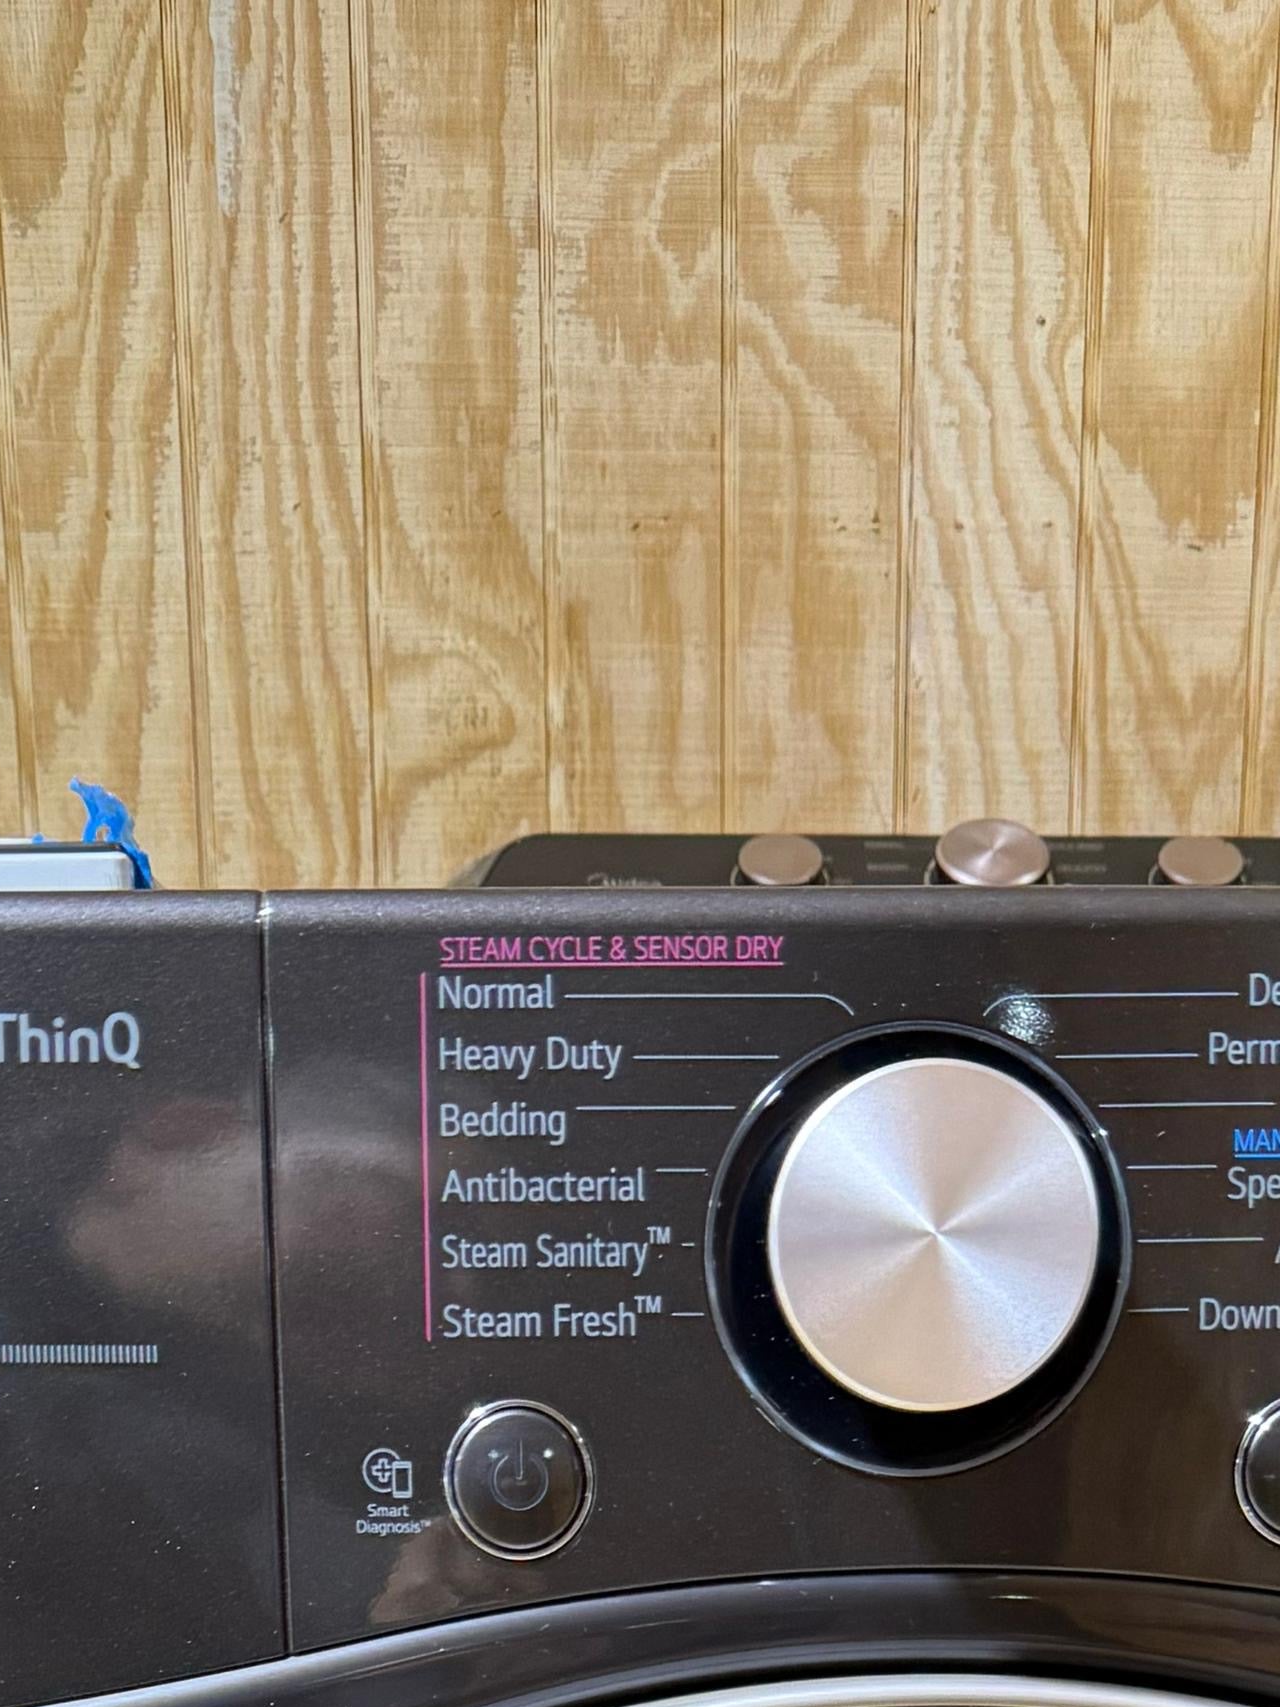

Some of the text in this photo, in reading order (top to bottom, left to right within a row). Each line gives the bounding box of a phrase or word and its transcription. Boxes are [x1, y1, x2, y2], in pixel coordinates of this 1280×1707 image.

[439, 935, 784, 962] STEAM CYCLE & SENSOR DRY
[437, 973, 555, 1010] Normal
[438, 1036, 623, 1081] Heavy Duty
[438, 1103, 567, 1146] Bedding
[441, 1166, 646, 1203] Antibacterial
[441, 1233, 527, 1269] Steam
[442, 1303, 542, 1338] Steam
[366, 1503, 411, 1517] Smart
